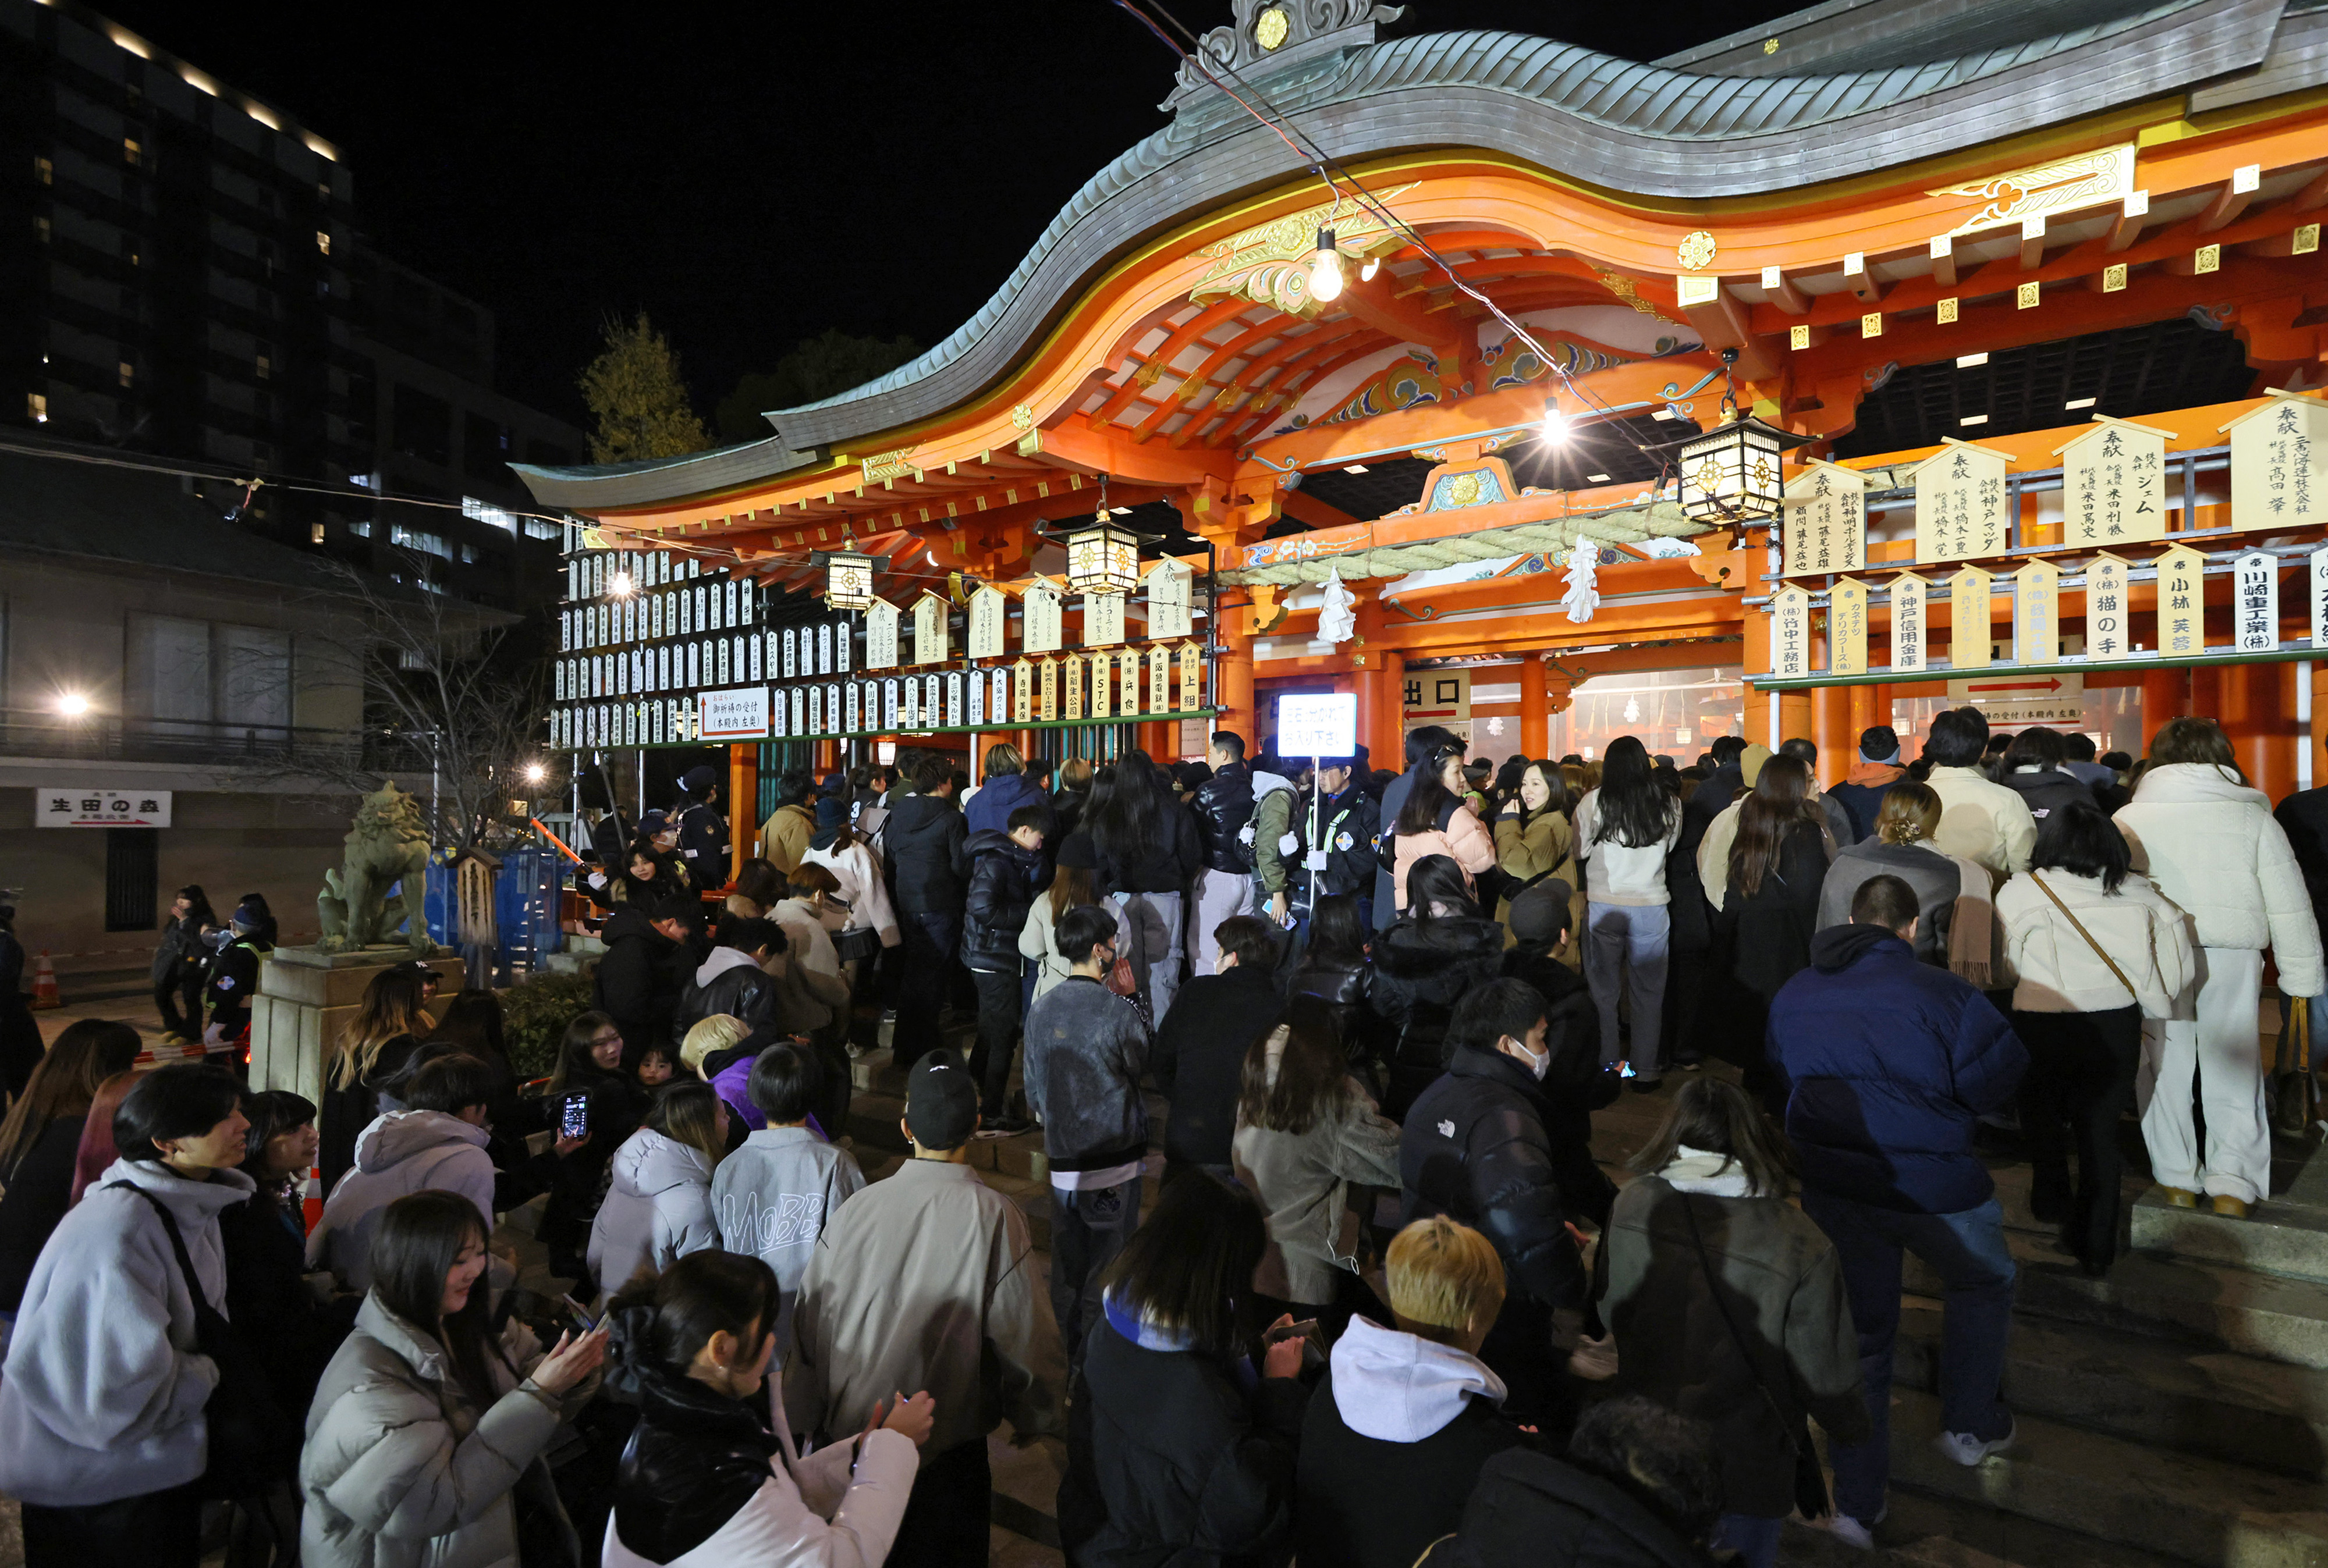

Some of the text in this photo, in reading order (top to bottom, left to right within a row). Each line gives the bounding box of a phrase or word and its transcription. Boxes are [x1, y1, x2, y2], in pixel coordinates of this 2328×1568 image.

[2277, 407, 2299, 435] 奉献
[2103, 431, 2125, 458] 奉献
[1952, 453, 1972, 481] 奉献
[1815, 474, 1833, 497] 奉献
[2135, 474, 2156, 514] ジェム
[1933, 515, 1950, 538] 橋本
[1981, 495, 1999, 552] 神戸マツダ
[2171, 578, 2189, 610] 小林
[2244, 571, 2270, 649] 川崎重工業(株)
[1851, 603, 1861, 636] カネテツ
[1900, 596, 1917, 667] 神戸信用金庫
[2096, 580, 2119, 654] (株)猫の手
[1783, 607, 1800, 674] (株)竹中工務店
[1154, 663, 1163, 712] 阪急電鉄(株)
[1184, 675, 1195, 707] 上組
[50, 798, 159, 812] 生田の森
